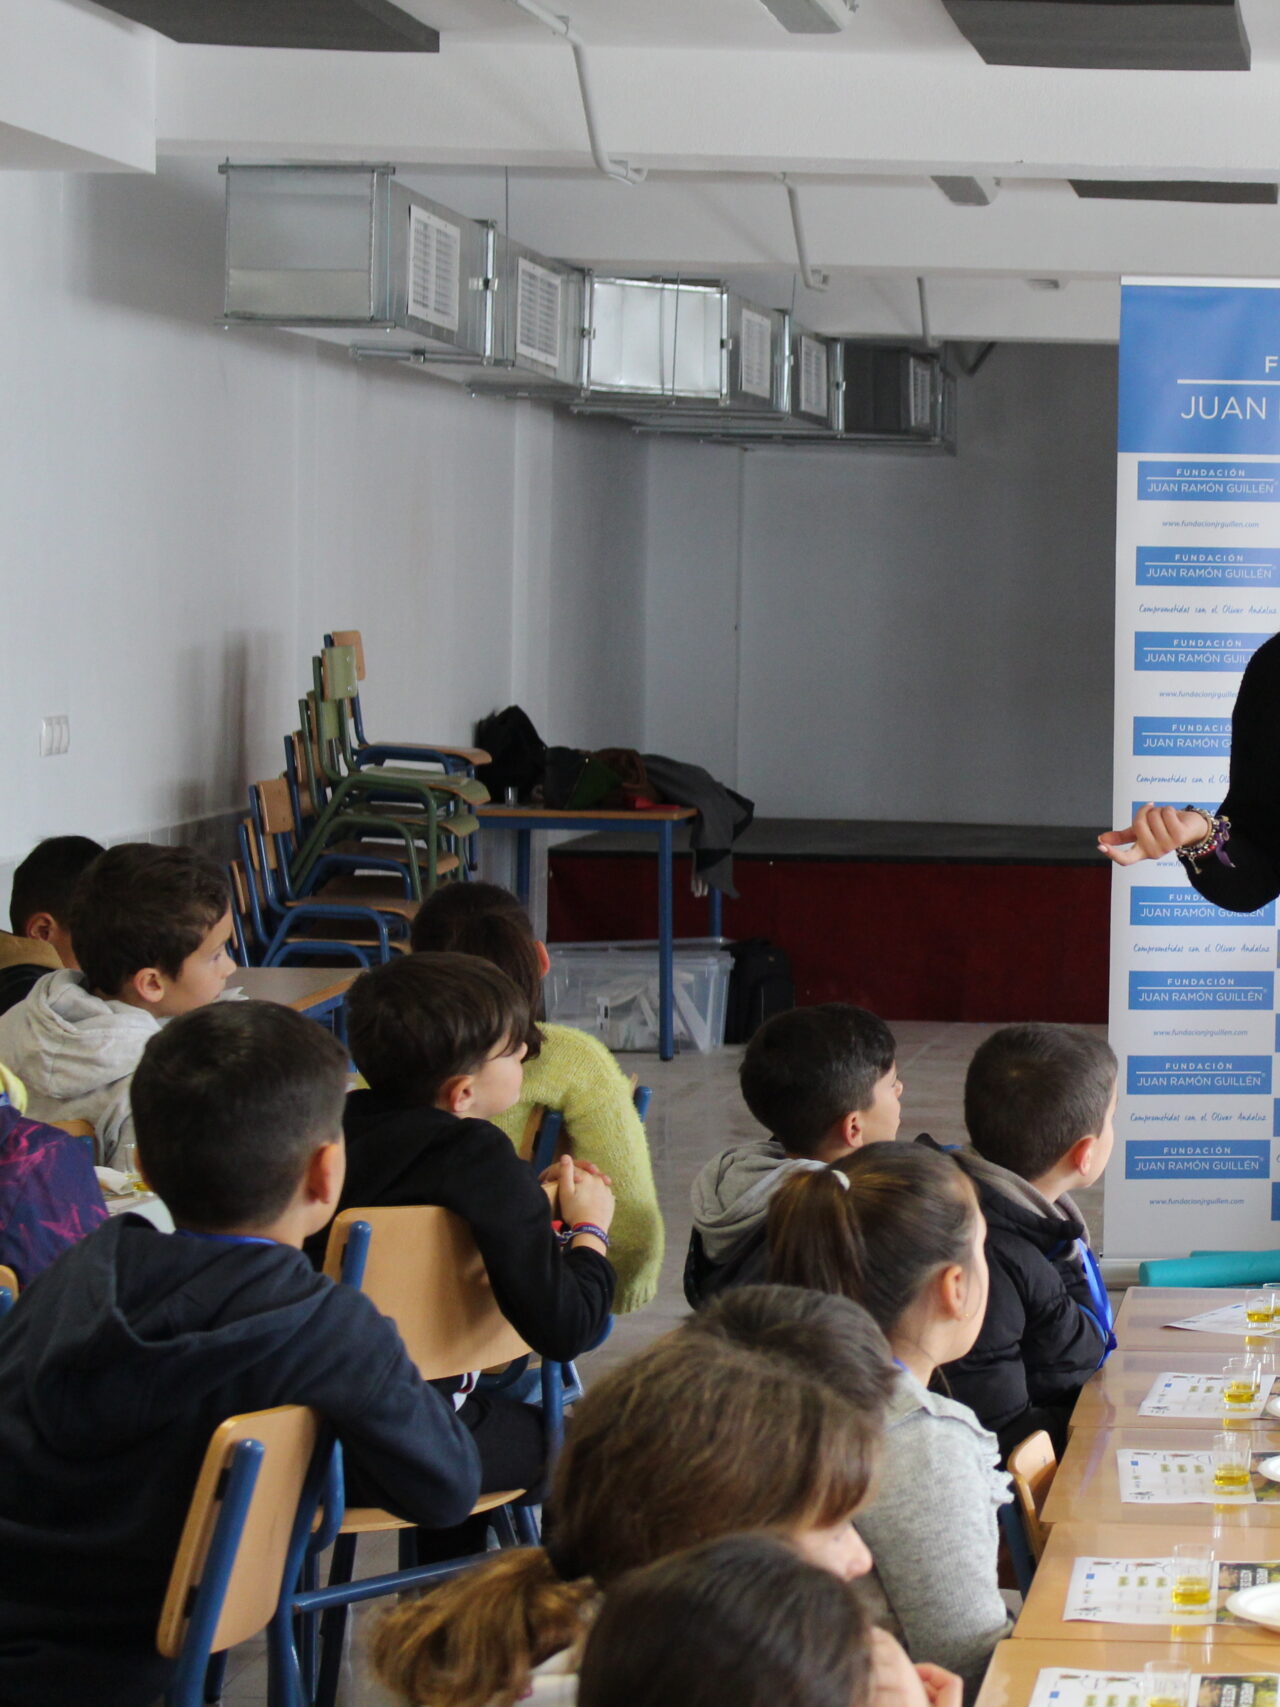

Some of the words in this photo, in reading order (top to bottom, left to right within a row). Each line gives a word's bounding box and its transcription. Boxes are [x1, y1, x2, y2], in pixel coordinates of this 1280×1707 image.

[1180, 396, 1266, 420] JUAN
[1176, 467, 1246, 477] FUNDACIÓN
[1147, 483, 1178, 493] JUAN
[1181, 481, 1224, 493] RAMÓN
[1226, 482, 1274, 494] GUILLÉN
[1162, 520, 1260, 529] www.fundacionjrguillen.com
[1175, 553, 1244, 562] FUNDACIÓN
[1146, 568, 1177, 577] JUAN
[1179, 567, 1222, 578] RAMÓN
[1225, 567, 1272, 579] GUILLÉN
[1173, 639, 1242, 647] FUNDACIÓN
[1145, 653, 1175, 663] JUAN
[1178, 652, 1220, 663] RAMÓN
[1223, 654, 1250, 664] GUIL
[1172, 723, 1232, 732] FUNDACIÓ
[1143, 738, 1174, 748] JUAN
[1177, 737, 1219, 748] RAMÓN
[1140, 908, 1170, 917] JUAN
[1174, 907, 1215, 917] RAMÓN
[1167, 977, 1235, 986] FUNDACIÓN
[1139, 992, 1169, 1001] JUAN
[1172, 991, 1213, 1001] RAMÓN
[1216, 991, 1263, 1001] GUILLÉN
[1153, 1029, 1248, 1037] www.fundacionjrguillen.com
[1165, 1062, 1233, 1070] FUNDACIÓN
[1137, 1077, 1167, 1086] JUAN
[1170, 1075, 1211, 1086] RAMÓN
[1214, 1075, 1261, 1086] GUILLÉN
[1163, 1146, 1231, 1154] FUNDACIÓN
[1135, 1161, 1165, 1171] JUAN
[1168, 1159, 1210, 1170] RAMÓN
[1213, 1159, 1259, 1170] GUILLÉN
[1149, 1198, 1245, 1206] www.fundacionjrguillen.com
